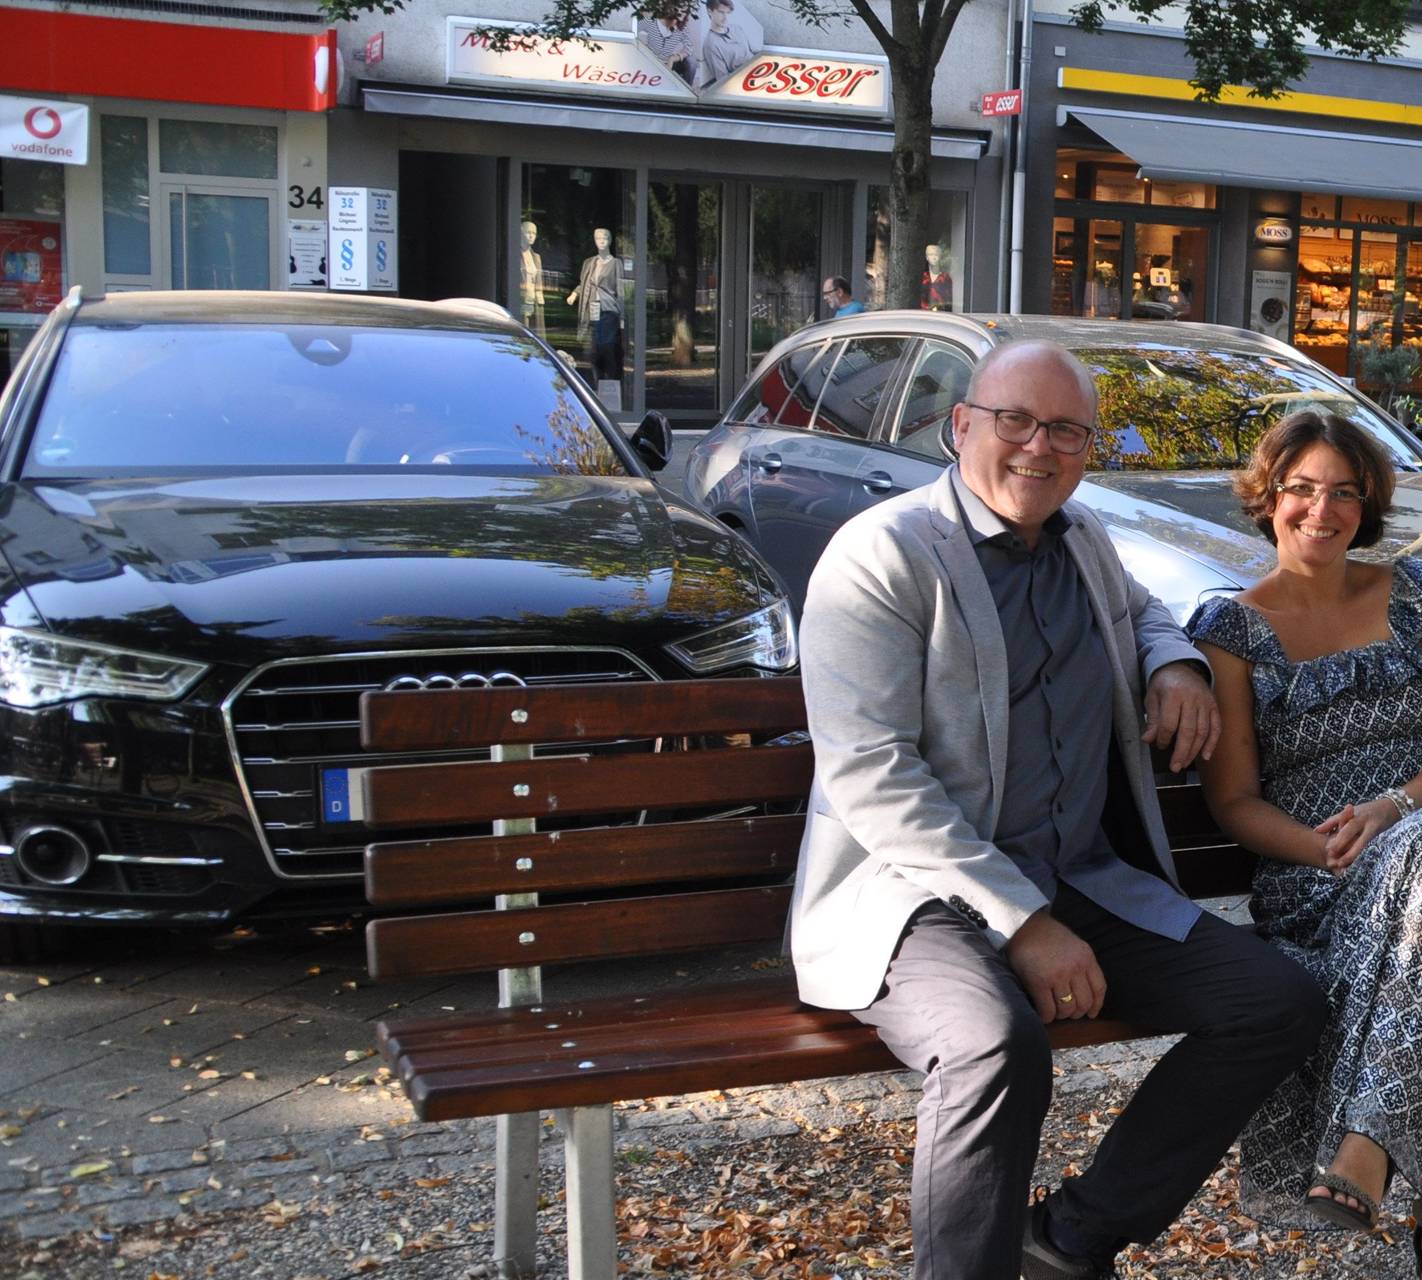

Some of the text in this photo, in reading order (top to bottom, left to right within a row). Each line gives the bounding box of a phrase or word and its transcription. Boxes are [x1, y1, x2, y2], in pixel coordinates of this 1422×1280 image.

[561, 63, 663, 87] Wäsche
[742, 61, 880, 98] esser
[10, 143, 73, 157] vodafone
[288, 184, 325, 210] 34
[1260, 228, 1288, 237] MOSS
[331, 800, 341, 813] D
